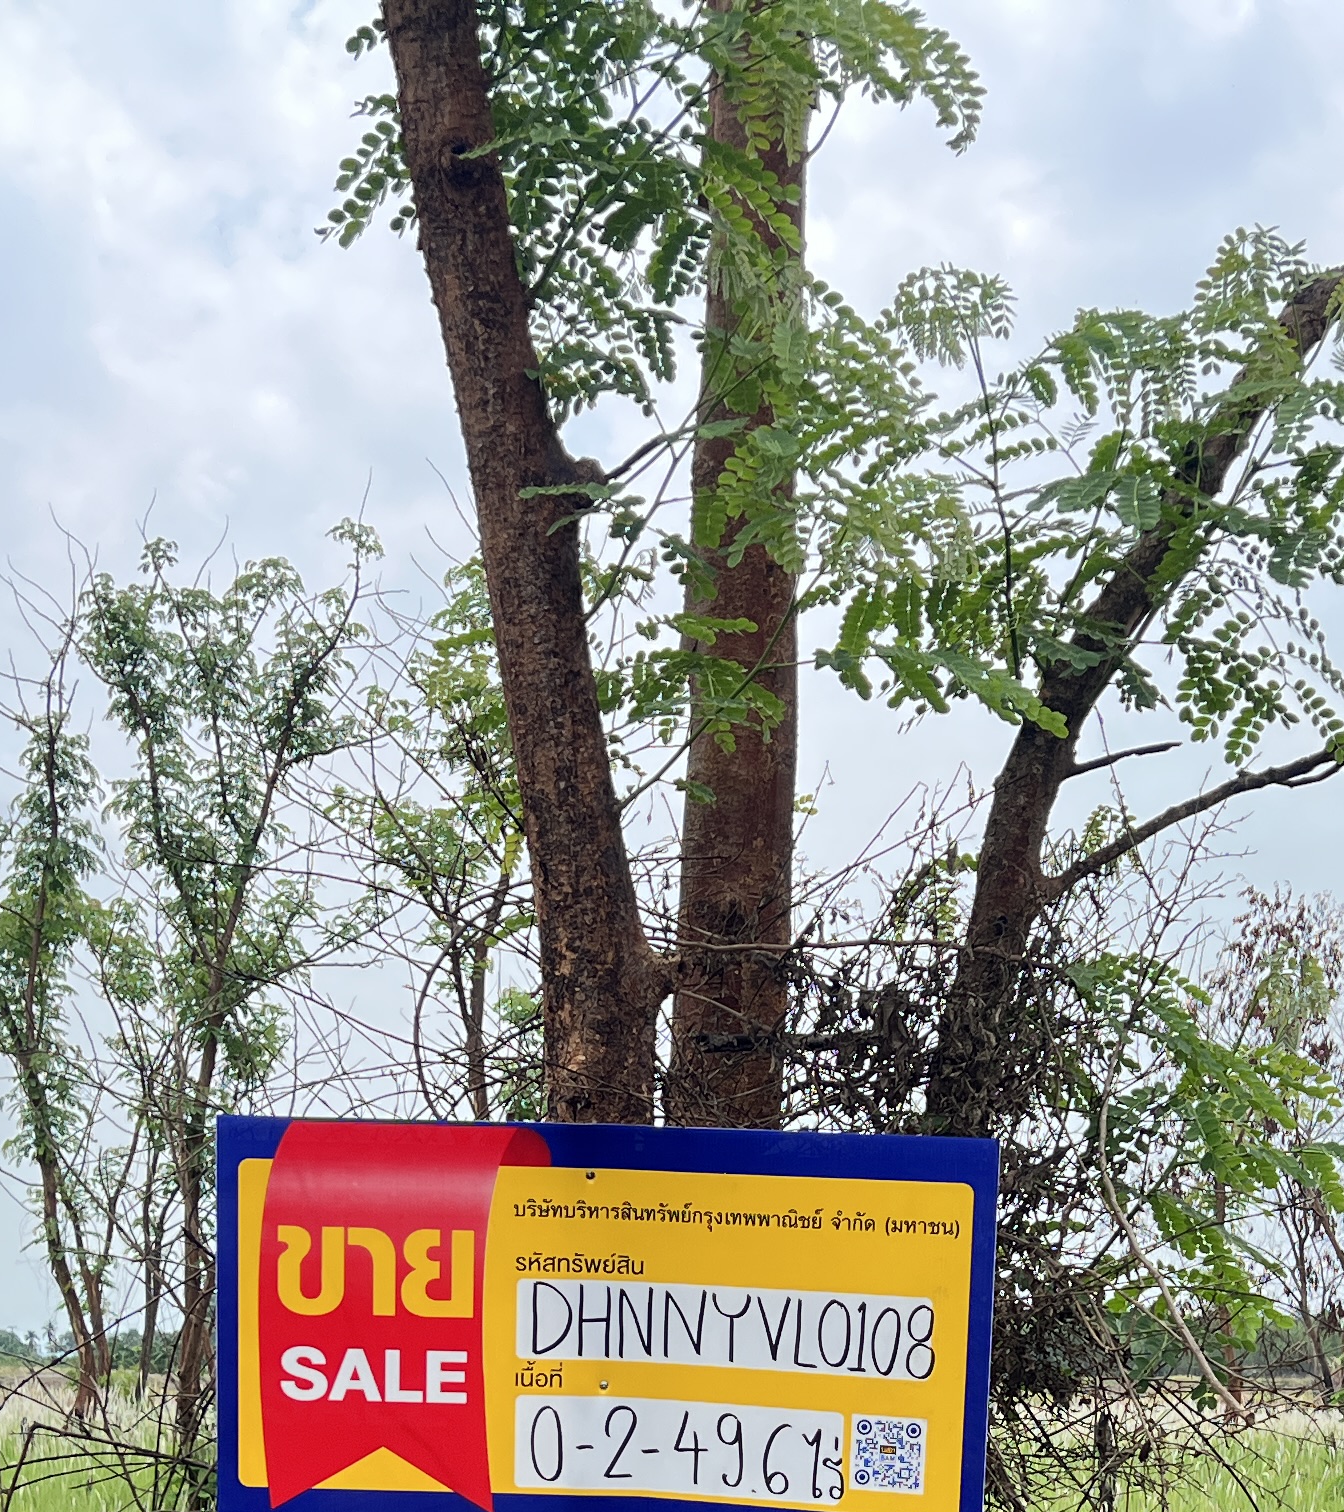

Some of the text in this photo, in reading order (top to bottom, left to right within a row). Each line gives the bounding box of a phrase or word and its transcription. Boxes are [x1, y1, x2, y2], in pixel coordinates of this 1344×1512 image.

[513, 1199, 961, 1238] บริษัทบริหารสินทรัพย์กรุงเทพพาณิชย์ จำกัด (มหาชน)
[277, 1225, 475, 1319] ขาย
[515, 1252, 645, 1276] รหัสทรัพย์สิน
[280, 1345, 468, 1404] SALE
[514, 1361, 564, 1389] เนื้อที่
